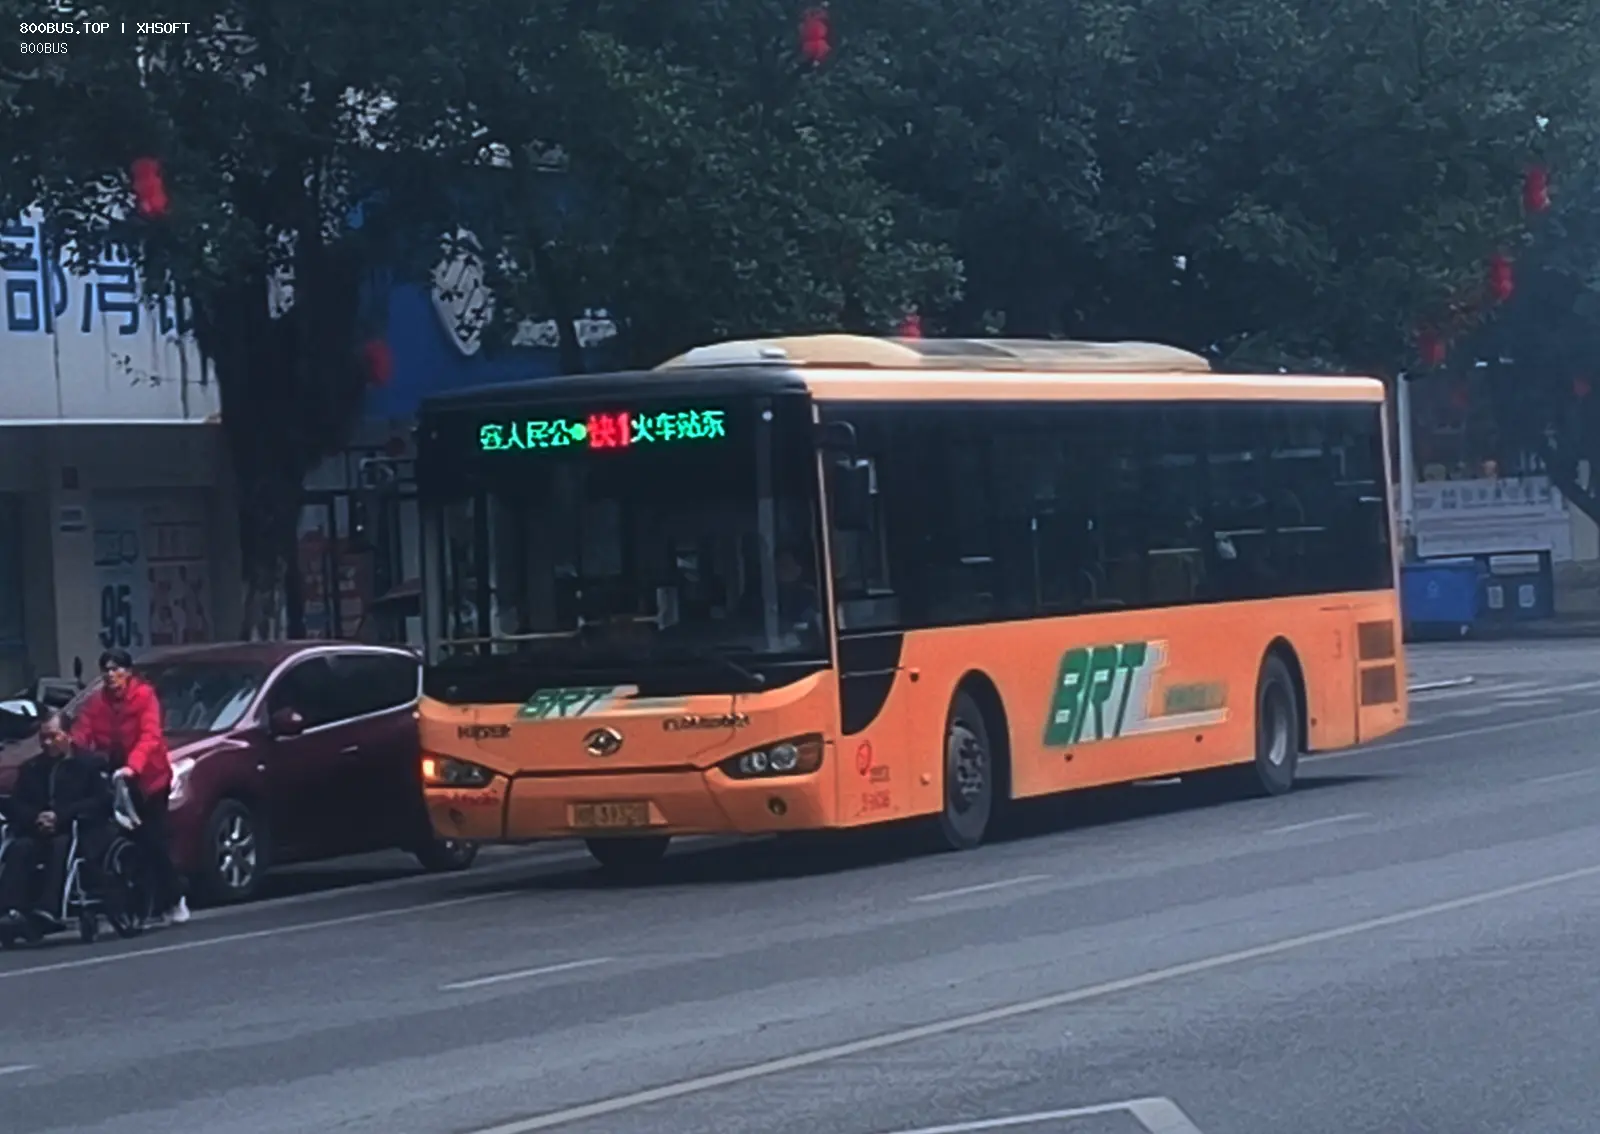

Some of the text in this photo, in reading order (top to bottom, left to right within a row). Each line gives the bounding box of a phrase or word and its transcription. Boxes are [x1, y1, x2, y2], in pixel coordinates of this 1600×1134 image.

[0, 222, 194, 335] 部湾
[515, 685, 622, 722] BRT
[1043, 640, 1152, 747] BRT
